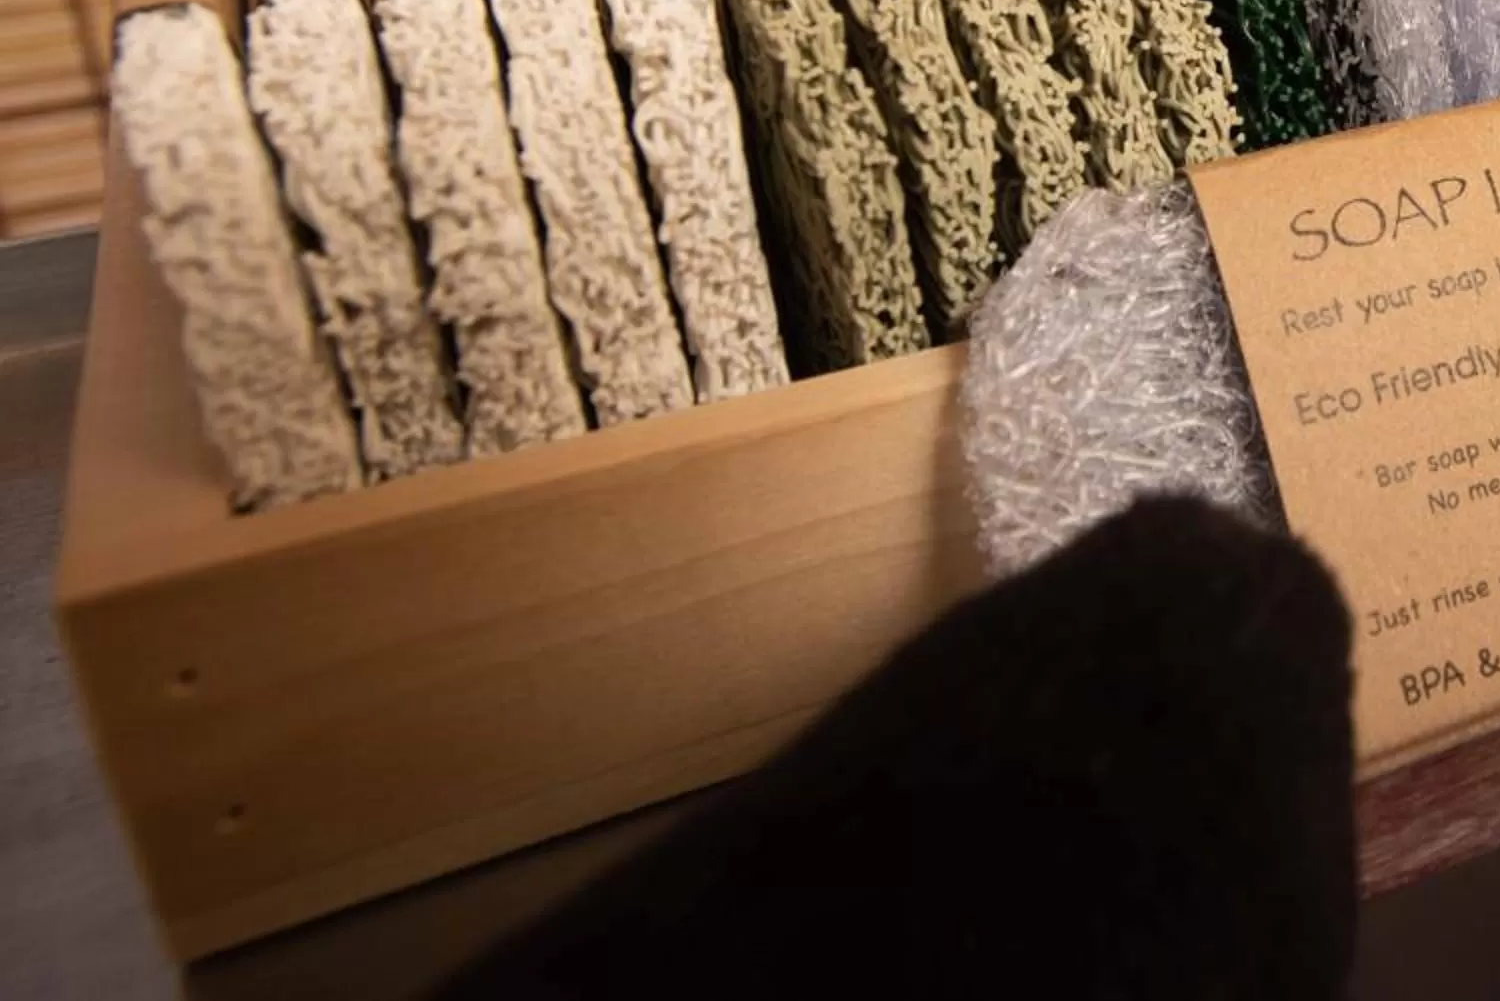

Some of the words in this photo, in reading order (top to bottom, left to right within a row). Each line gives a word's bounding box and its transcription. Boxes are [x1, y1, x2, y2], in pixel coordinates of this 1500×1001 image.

[1289, 176, 1467, 262] SOAP
[1281, 298, 1344, 337] Rest
[1356, 283, 1417, 324] your
[1427, 266, 1488, 299] soap
[1293, 385, 1362, 426] Eco
[1374, 461, 1417, 489] Bar
[1427, 443, 1481, 472] soap
[1427, 489, 1461, 515] No
[1367, 606, 1420, 637] Just
[1431, 579, 1491, 613] rinse
[1399, 660, 1467, 707] BPA
